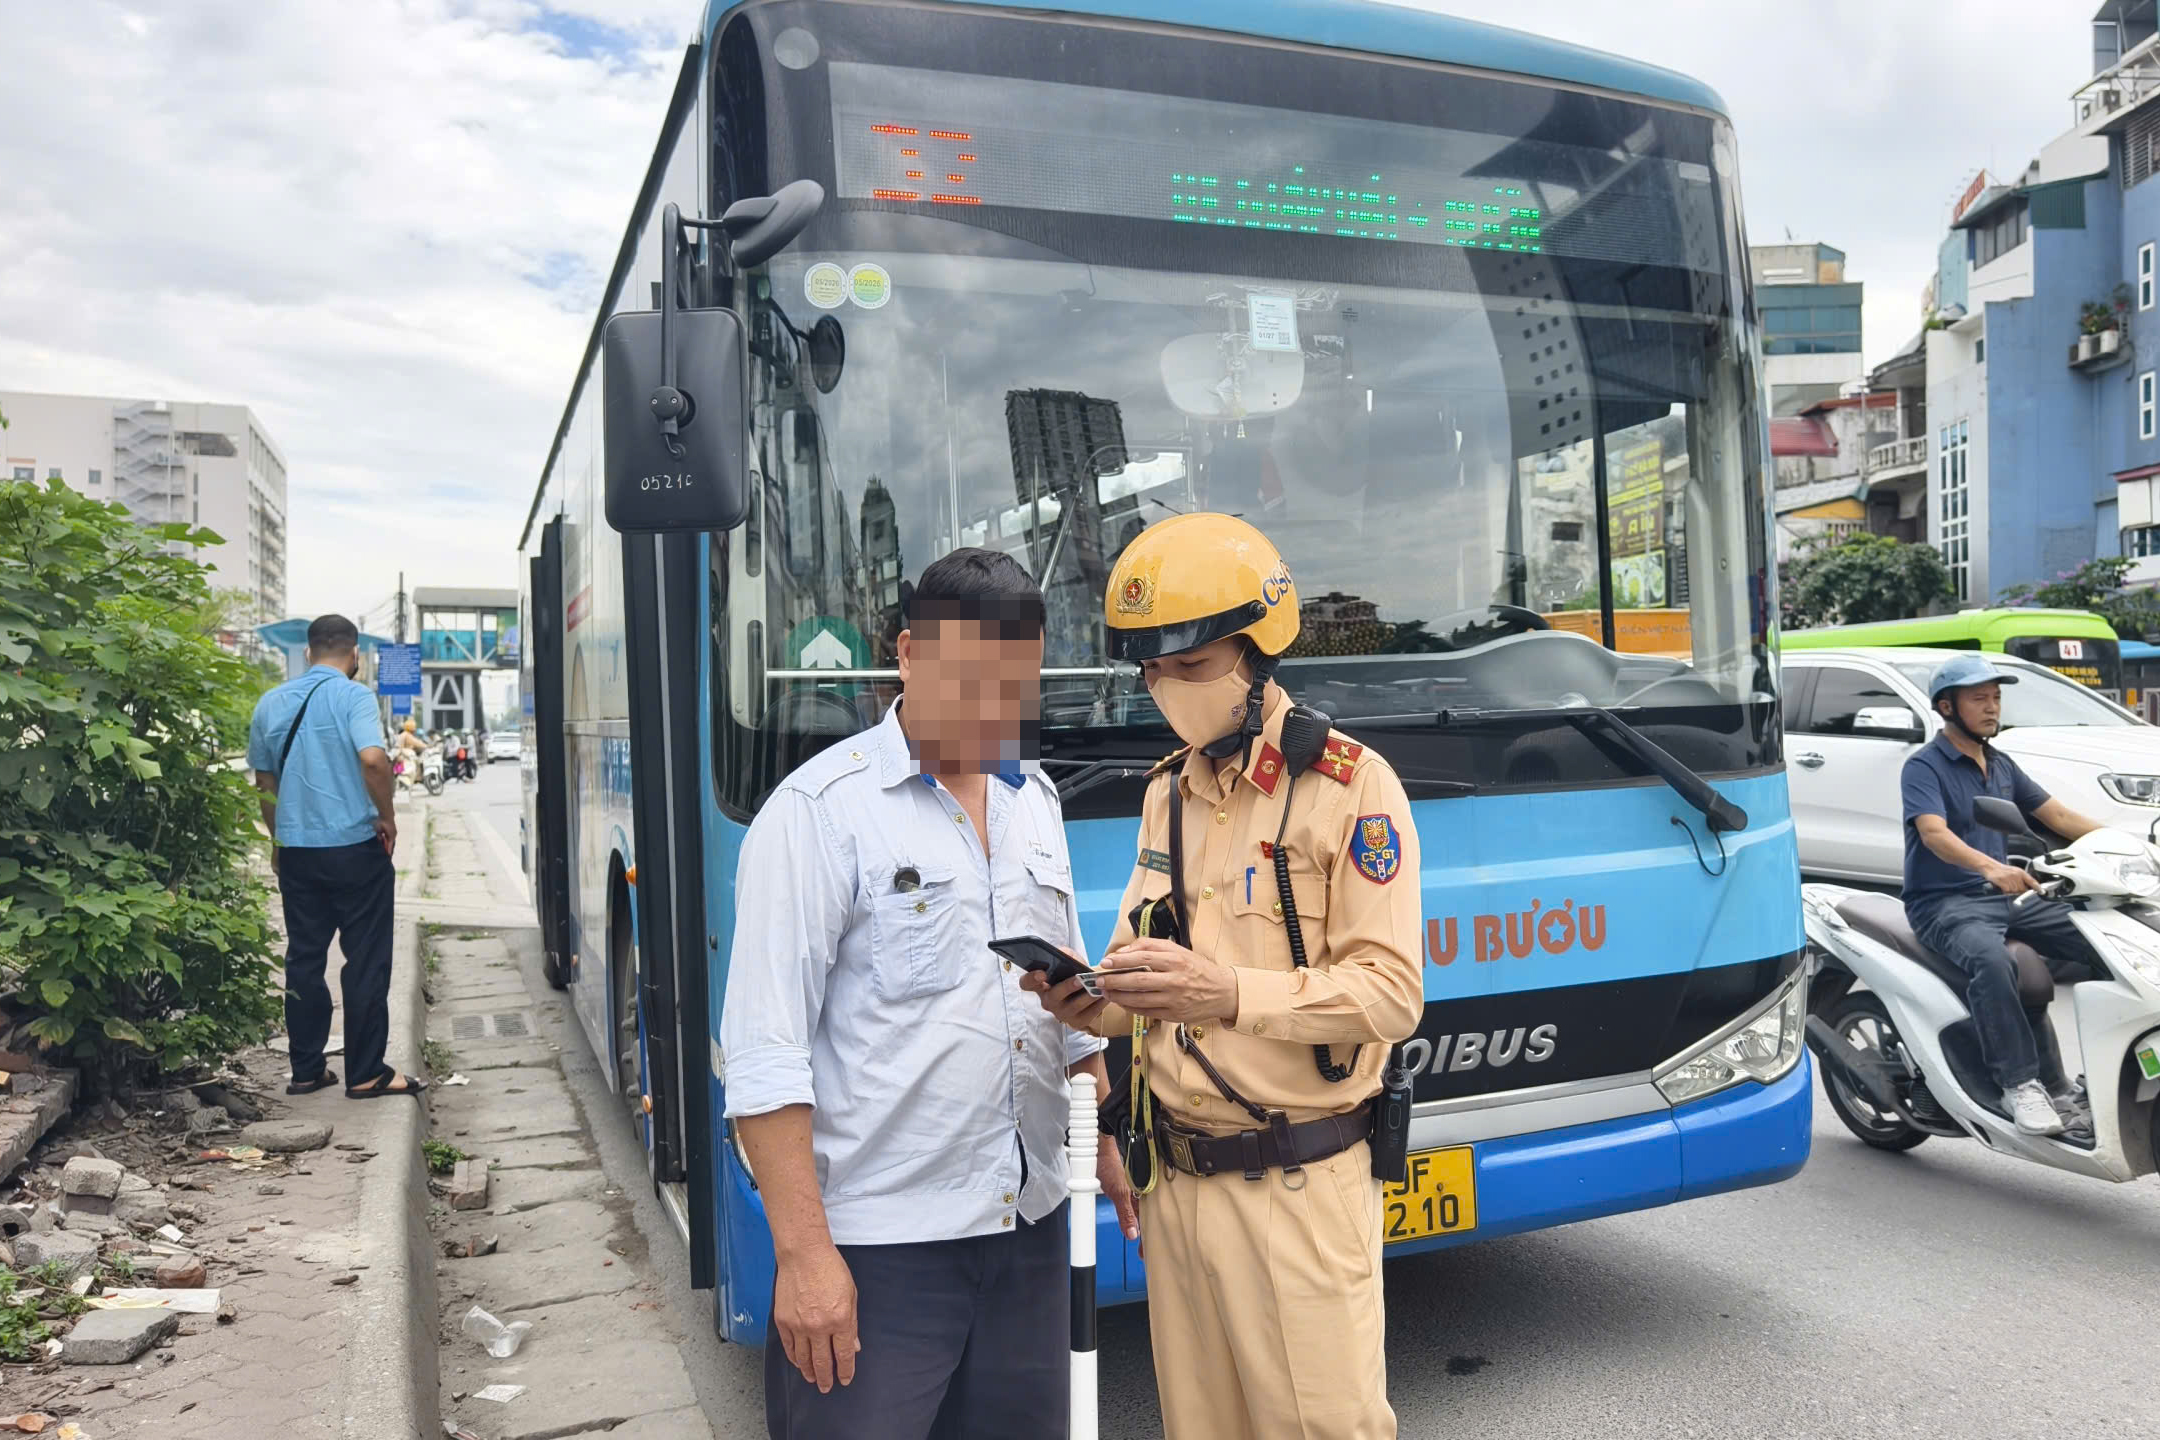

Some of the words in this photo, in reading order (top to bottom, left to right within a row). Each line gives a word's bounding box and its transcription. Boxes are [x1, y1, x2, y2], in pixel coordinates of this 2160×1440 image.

[2063, 644, 2079, 657] 41
[1361, 851, 1377, 863] CS
[1382, 848, 1395, 860] GT
[1383, 1194, 1459, 1237] 2.10
